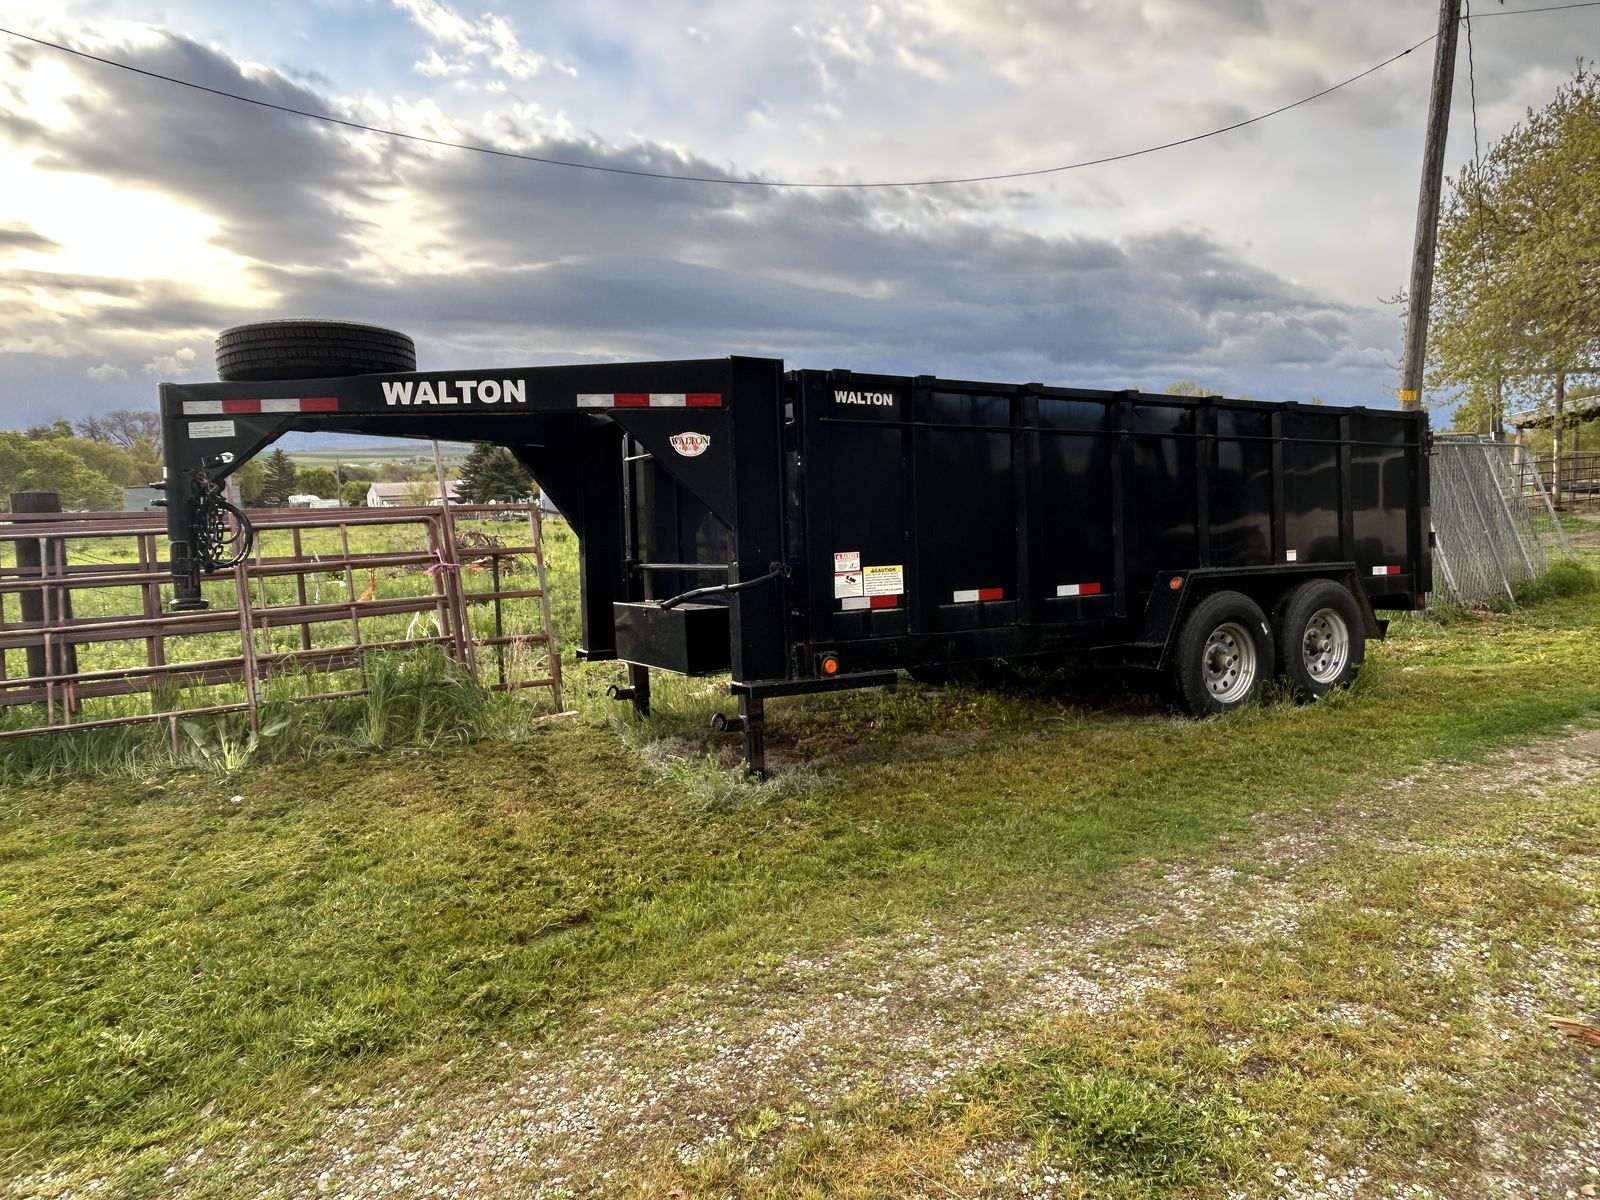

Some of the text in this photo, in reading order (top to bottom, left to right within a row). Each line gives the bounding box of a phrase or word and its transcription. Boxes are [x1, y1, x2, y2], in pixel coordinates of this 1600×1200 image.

[381, 379, 526, 405] WALTON
[834, 390, 893, 406] WALTON
[670, 436, 709, 446] WALTON
